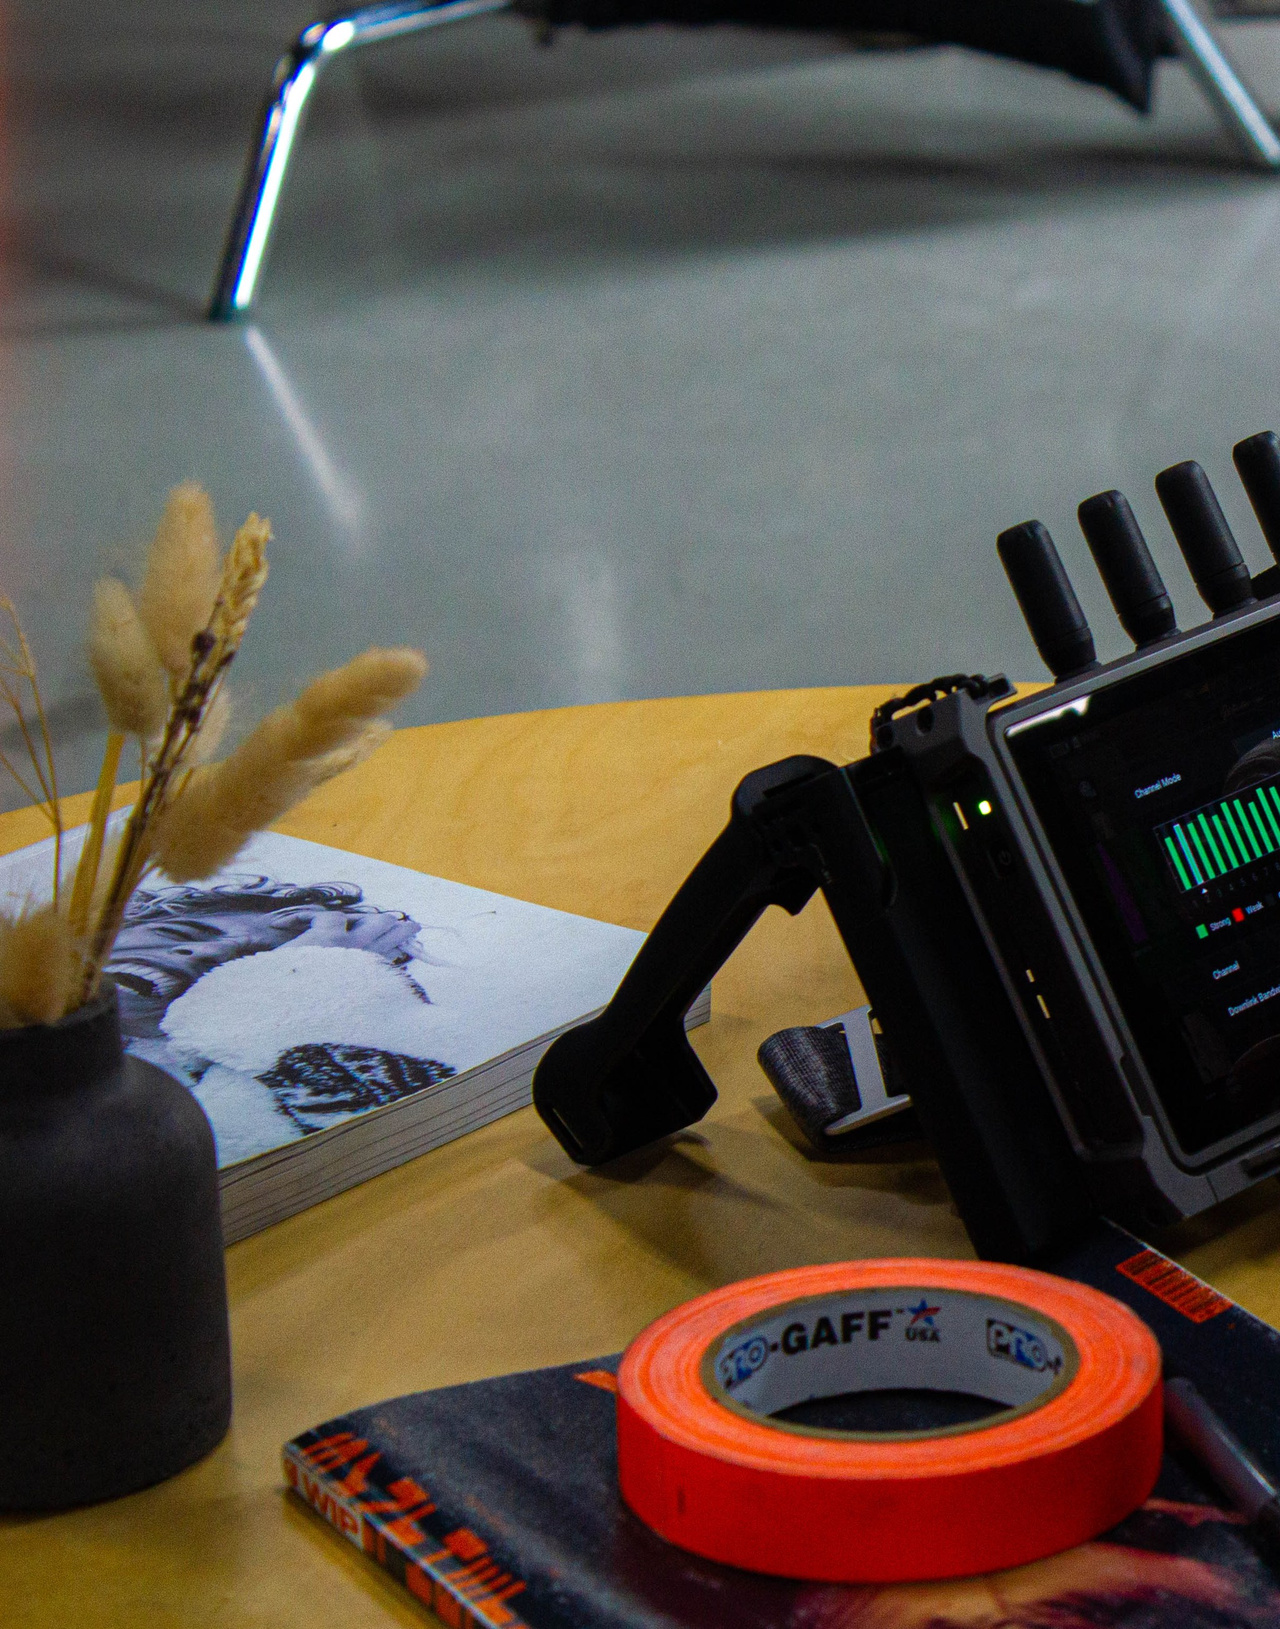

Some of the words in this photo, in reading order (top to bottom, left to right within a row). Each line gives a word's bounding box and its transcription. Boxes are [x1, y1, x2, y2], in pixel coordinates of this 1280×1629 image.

[1133, 779, 1162, 799] Channel
[1160, 773, 1182, 789] Mode
[1209, 916, 1232, 931] Strong
[1211, 960, 1240, 980] Channel
[1227, 995, 1258, 1017] Downlink
[906, 1328, 940, 1342] USA
